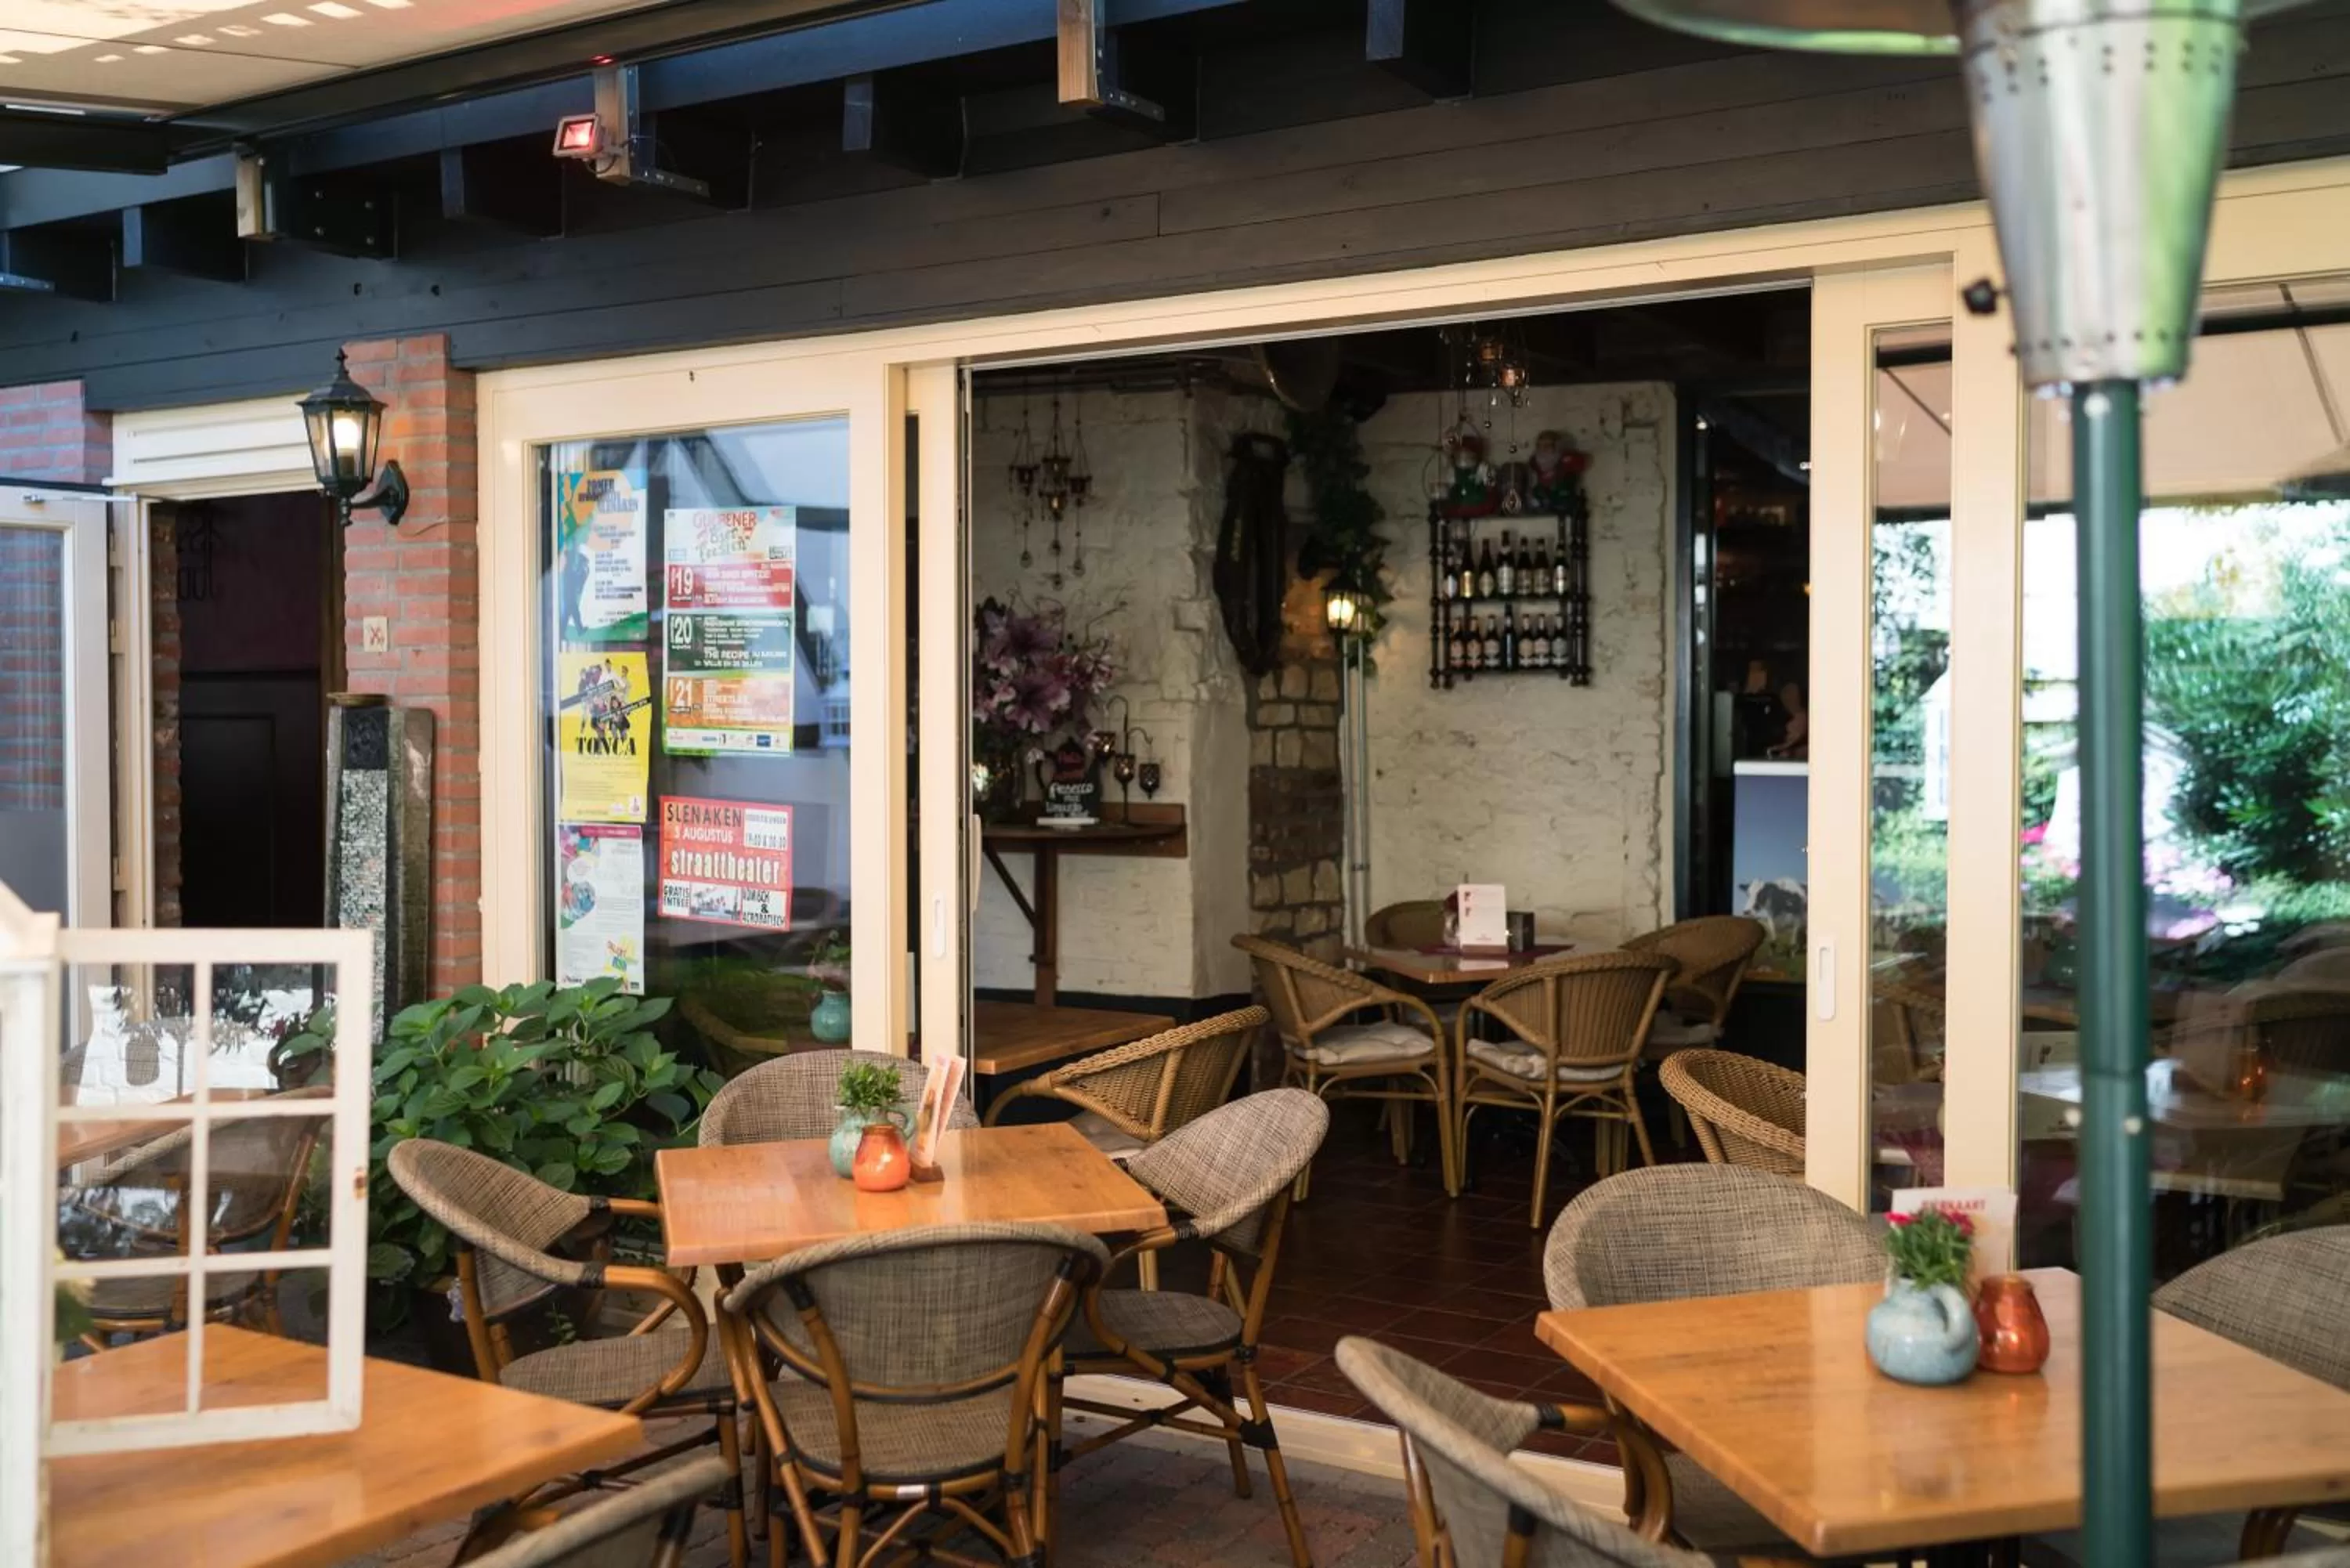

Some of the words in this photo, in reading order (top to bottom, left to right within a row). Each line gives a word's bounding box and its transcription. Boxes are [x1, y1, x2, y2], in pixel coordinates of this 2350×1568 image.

[692, 511, 757, 528] GUPENER
[675, 566, 693, 595] 19
[674, 616, 692, 644] 20
[675, 678, 692, 706] 21
[667, 803, 742, 827] SLENAKEN
[682, 826, 734, 844] AUGUSTUS
[671, 848, 780, 884] straattheater
[761, 903, 769, 913] &
